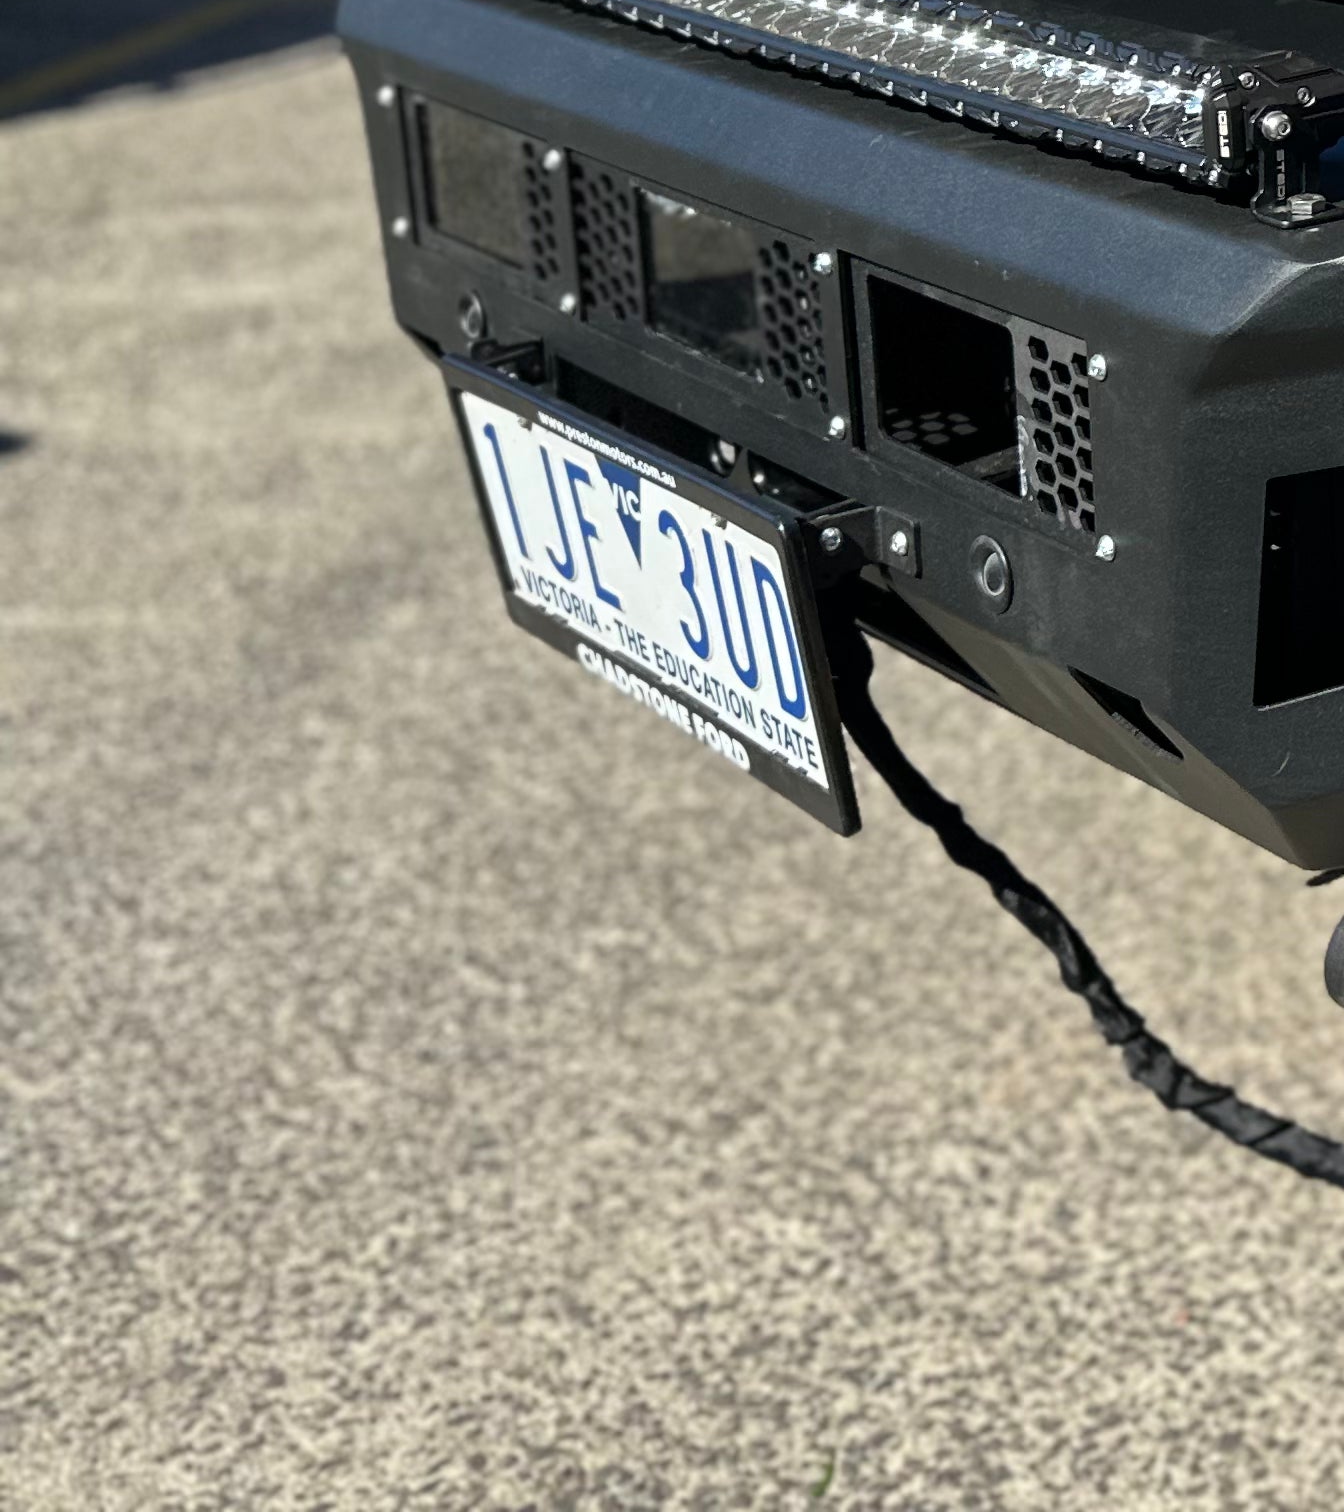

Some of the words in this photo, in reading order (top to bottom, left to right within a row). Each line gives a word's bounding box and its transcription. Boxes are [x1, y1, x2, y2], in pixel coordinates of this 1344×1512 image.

[520, 565, 604, 634] VICTORIA
[613, 617, 651, 663] THE
[652, 641, 757, 730] EDUCATION
[759, 706, 820, 770] STATE
[690, 711, 751, 772] FORD
